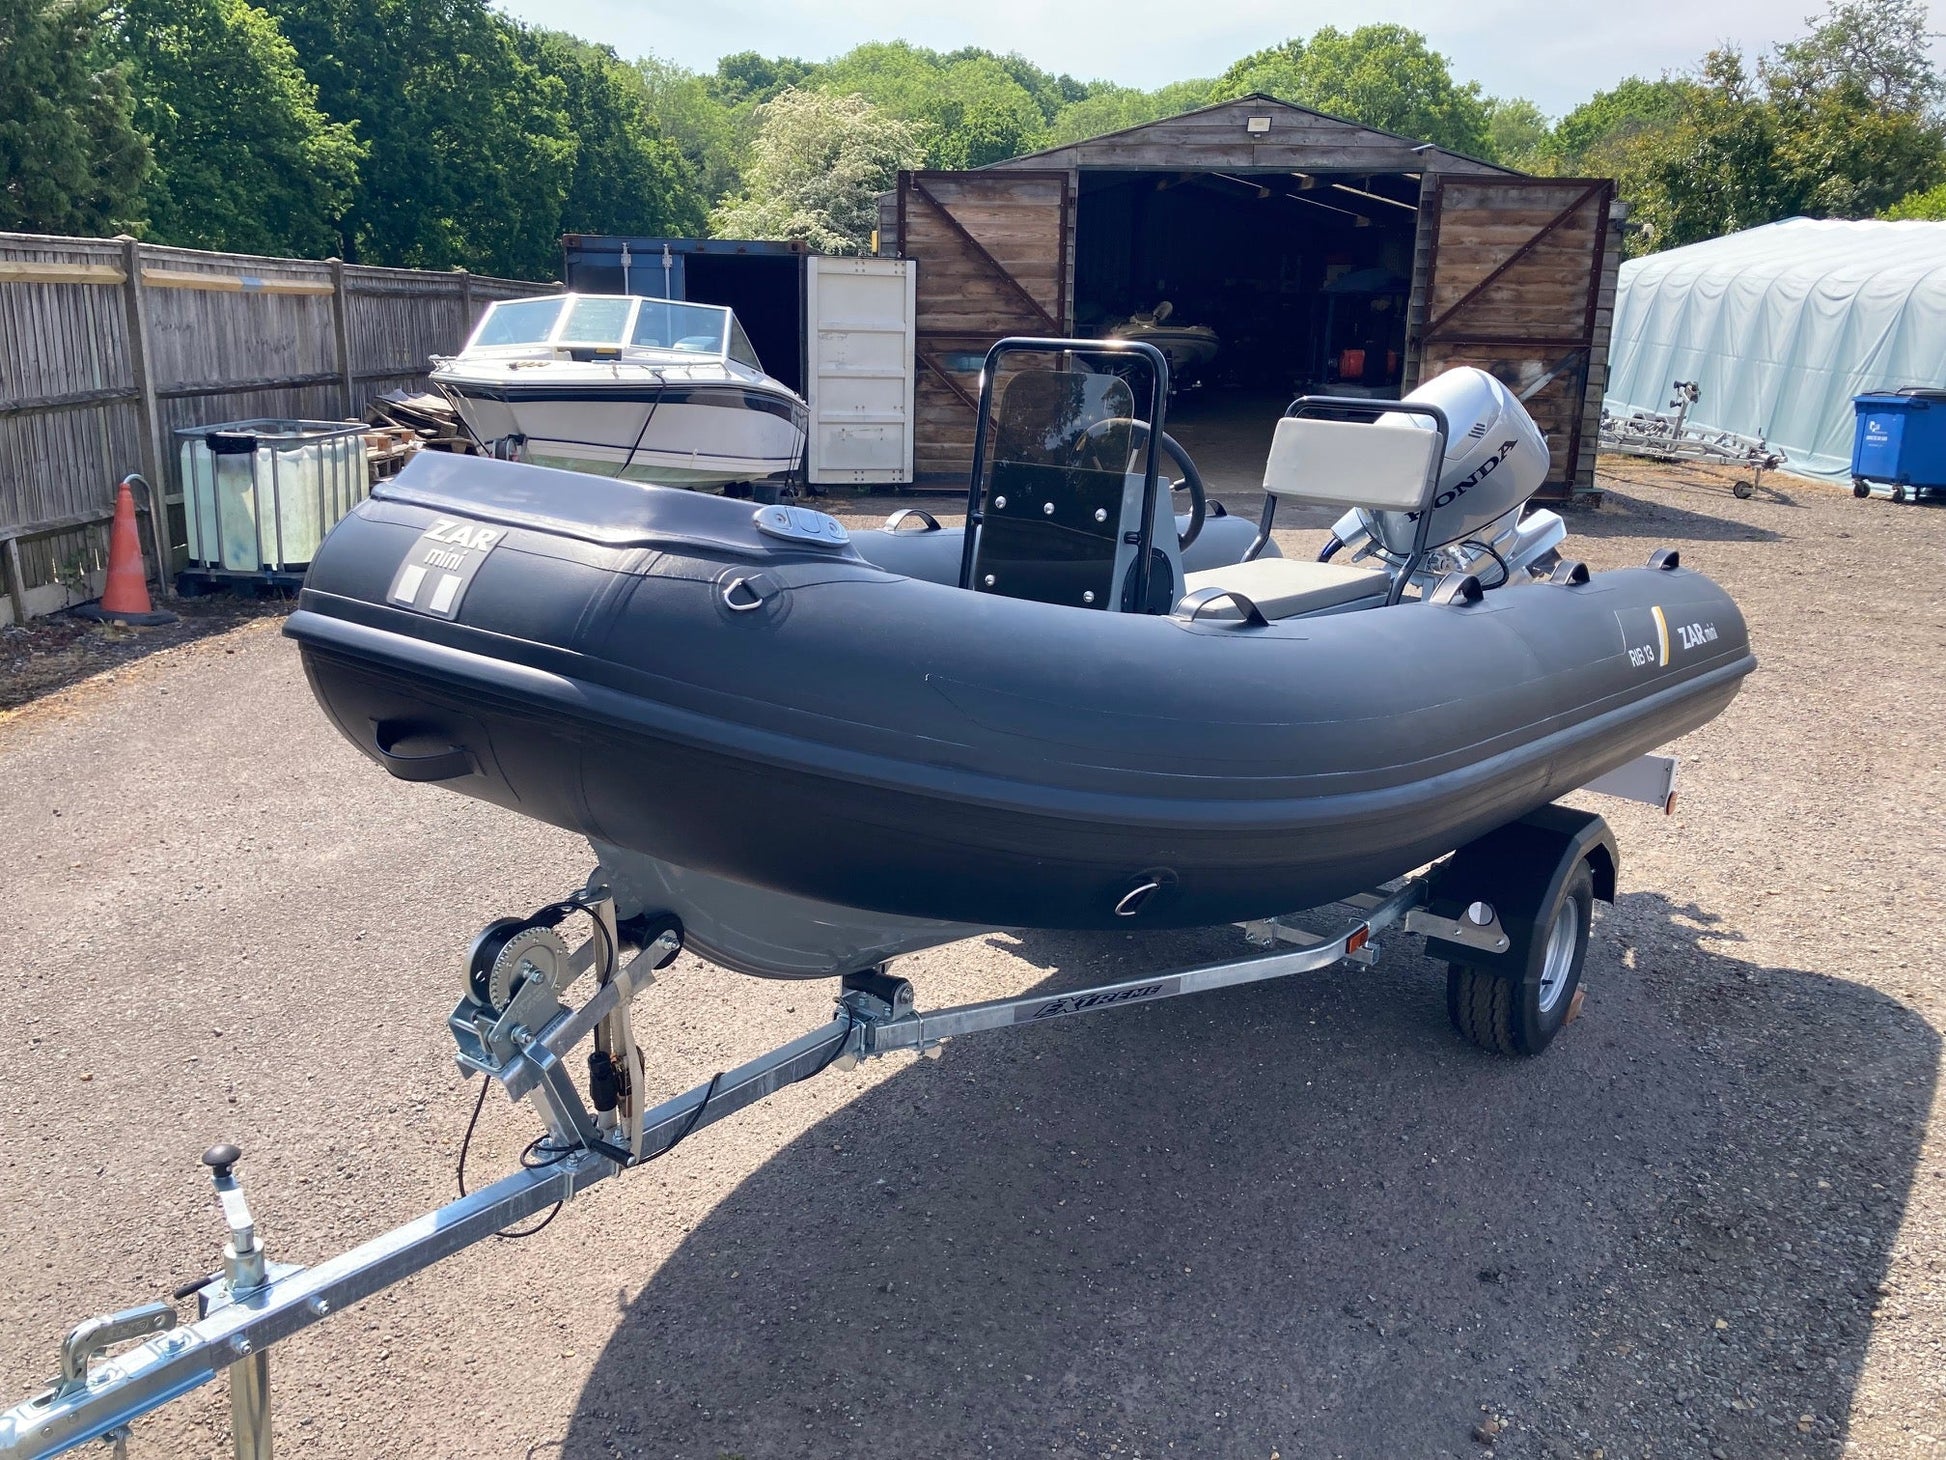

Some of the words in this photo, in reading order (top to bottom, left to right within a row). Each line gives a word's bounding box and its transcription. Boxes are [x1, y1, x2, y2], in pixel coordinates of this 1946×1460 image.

[423, 519, 498, 552] ZAR
[424, 546, 469, 572] mini
[1677, 623, 1707, 650] ZAR
[1704, 622, 1719, 642] mini
[1628, 647, 1646, 668] RIB
[1643, 644, 1655, 662] 13
[1032, 984, 1164, 1019] EXTREME
